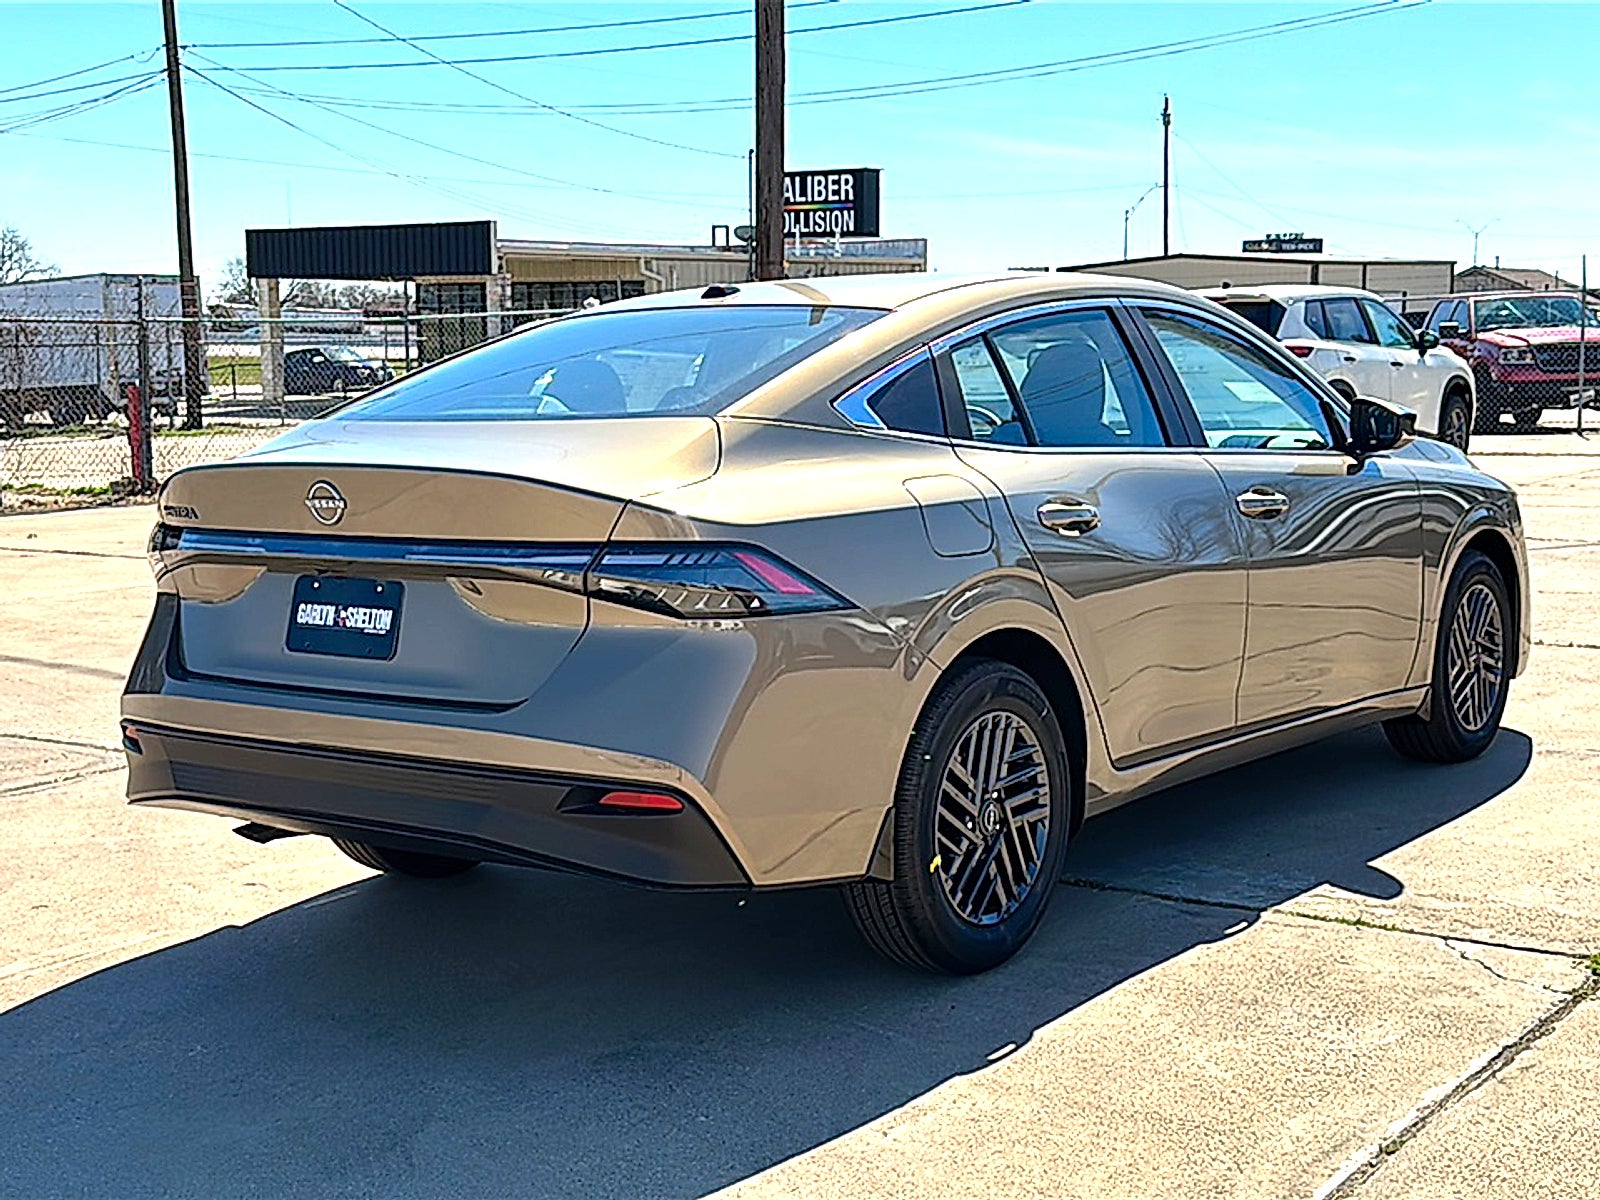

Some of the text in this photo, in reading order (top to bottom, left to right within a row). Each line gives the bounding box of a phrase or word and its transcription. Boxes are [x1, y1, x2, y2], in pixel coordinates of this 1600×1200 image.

[783, 173, 854, 203] ALIBER
[783, 209, 855, 233] OLLISION
[345, 606, 393, 630] SHELTON
